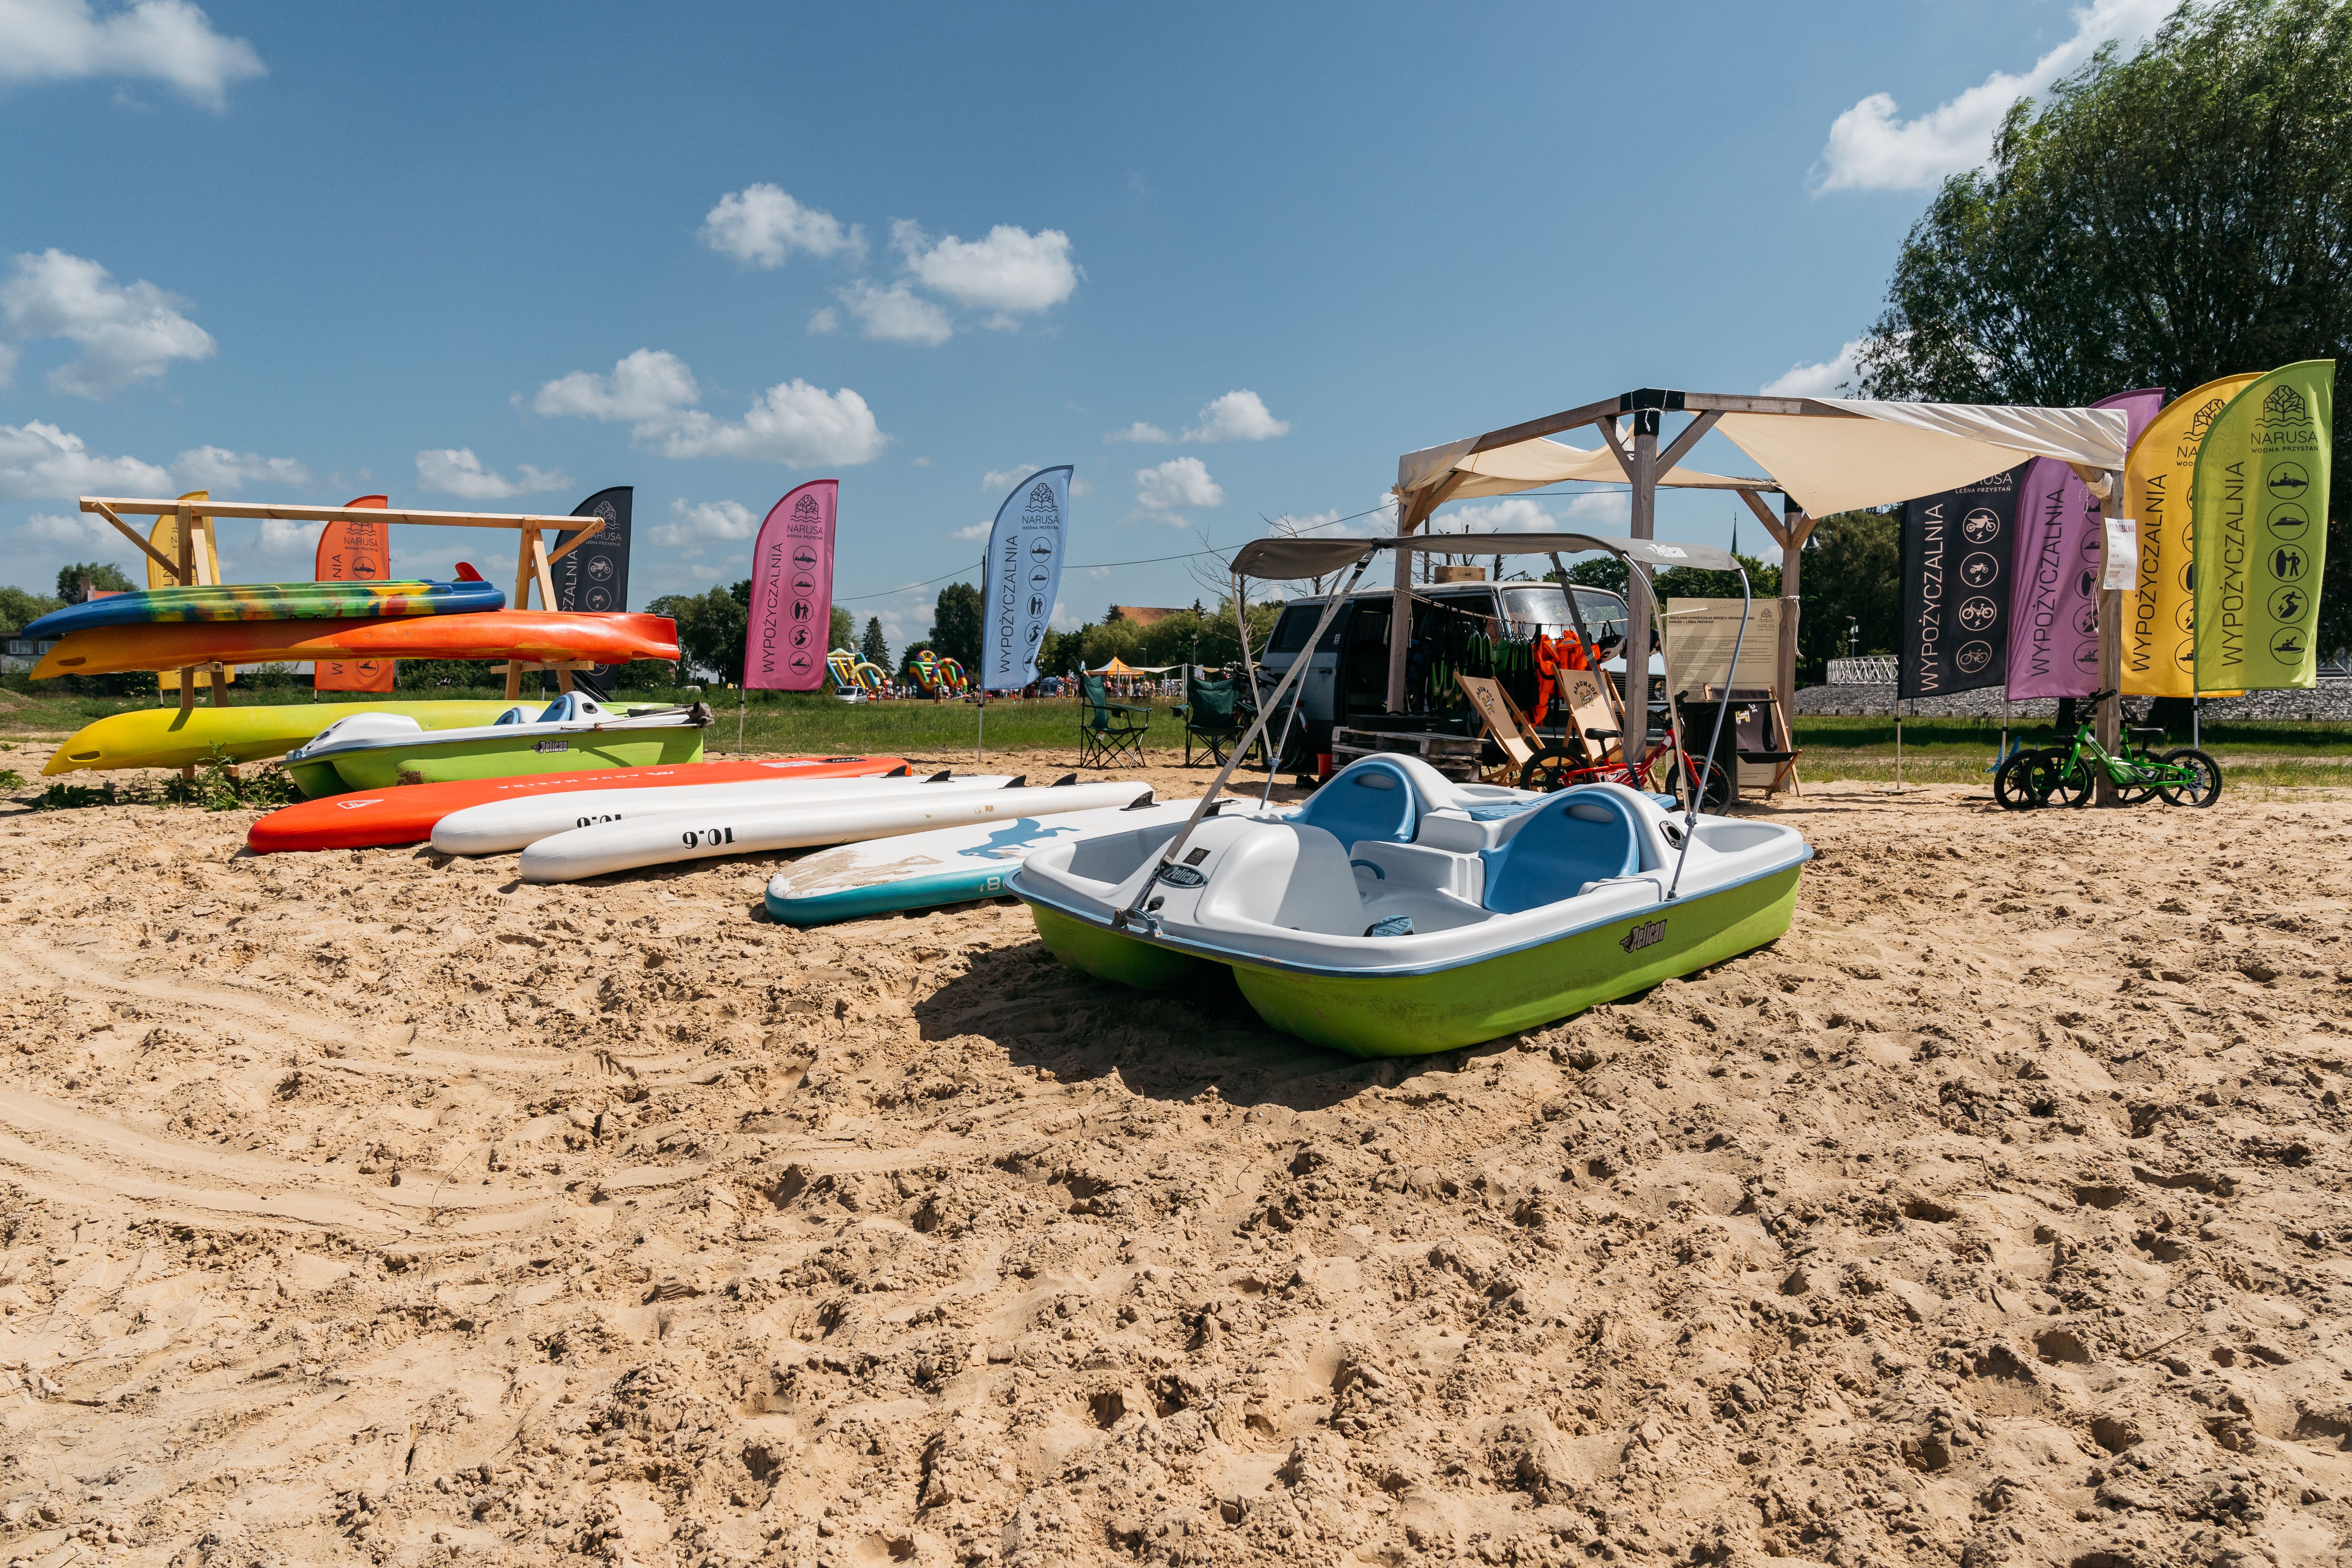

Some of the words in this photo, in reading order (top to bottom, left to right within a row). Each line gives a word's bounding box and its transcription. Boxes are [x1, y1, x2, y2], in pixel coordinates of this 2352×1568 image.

[2251, 431, 2318, 445] NARUSA
[1022, 515, 1059, 524] NARUSA
[588, 531, 622, 541] ARUSA
[787, 524, 823, 535] NARUSA
[344, 536, 378, 547] NARUSA
[2132, 474, 2168, 672] WYPOŻYCZALNIA
[2220, 461, 2245, 666] WYPOŻYCZALNIA
[2031, 488, 2064, 676] WYPOŻYCZALNIA
[999, 535, 1018, 673] WYPOŻYCZALNIA
[1919, 503, 1943, 691] WYPOŻYCZALNIA
[762, 543, 783, 672] WYPOŻYCZALNIA
[1573, 681, 1598, 696] HARDMADE
[538, 740, 568, 753] Pelican
[496, 779, 579, 789] MARINA
[682, 827, 736, 849] 10.6
[1167, 866, 1200, 885] Pelican
[1629, 920, 1666, 952] Pelican
